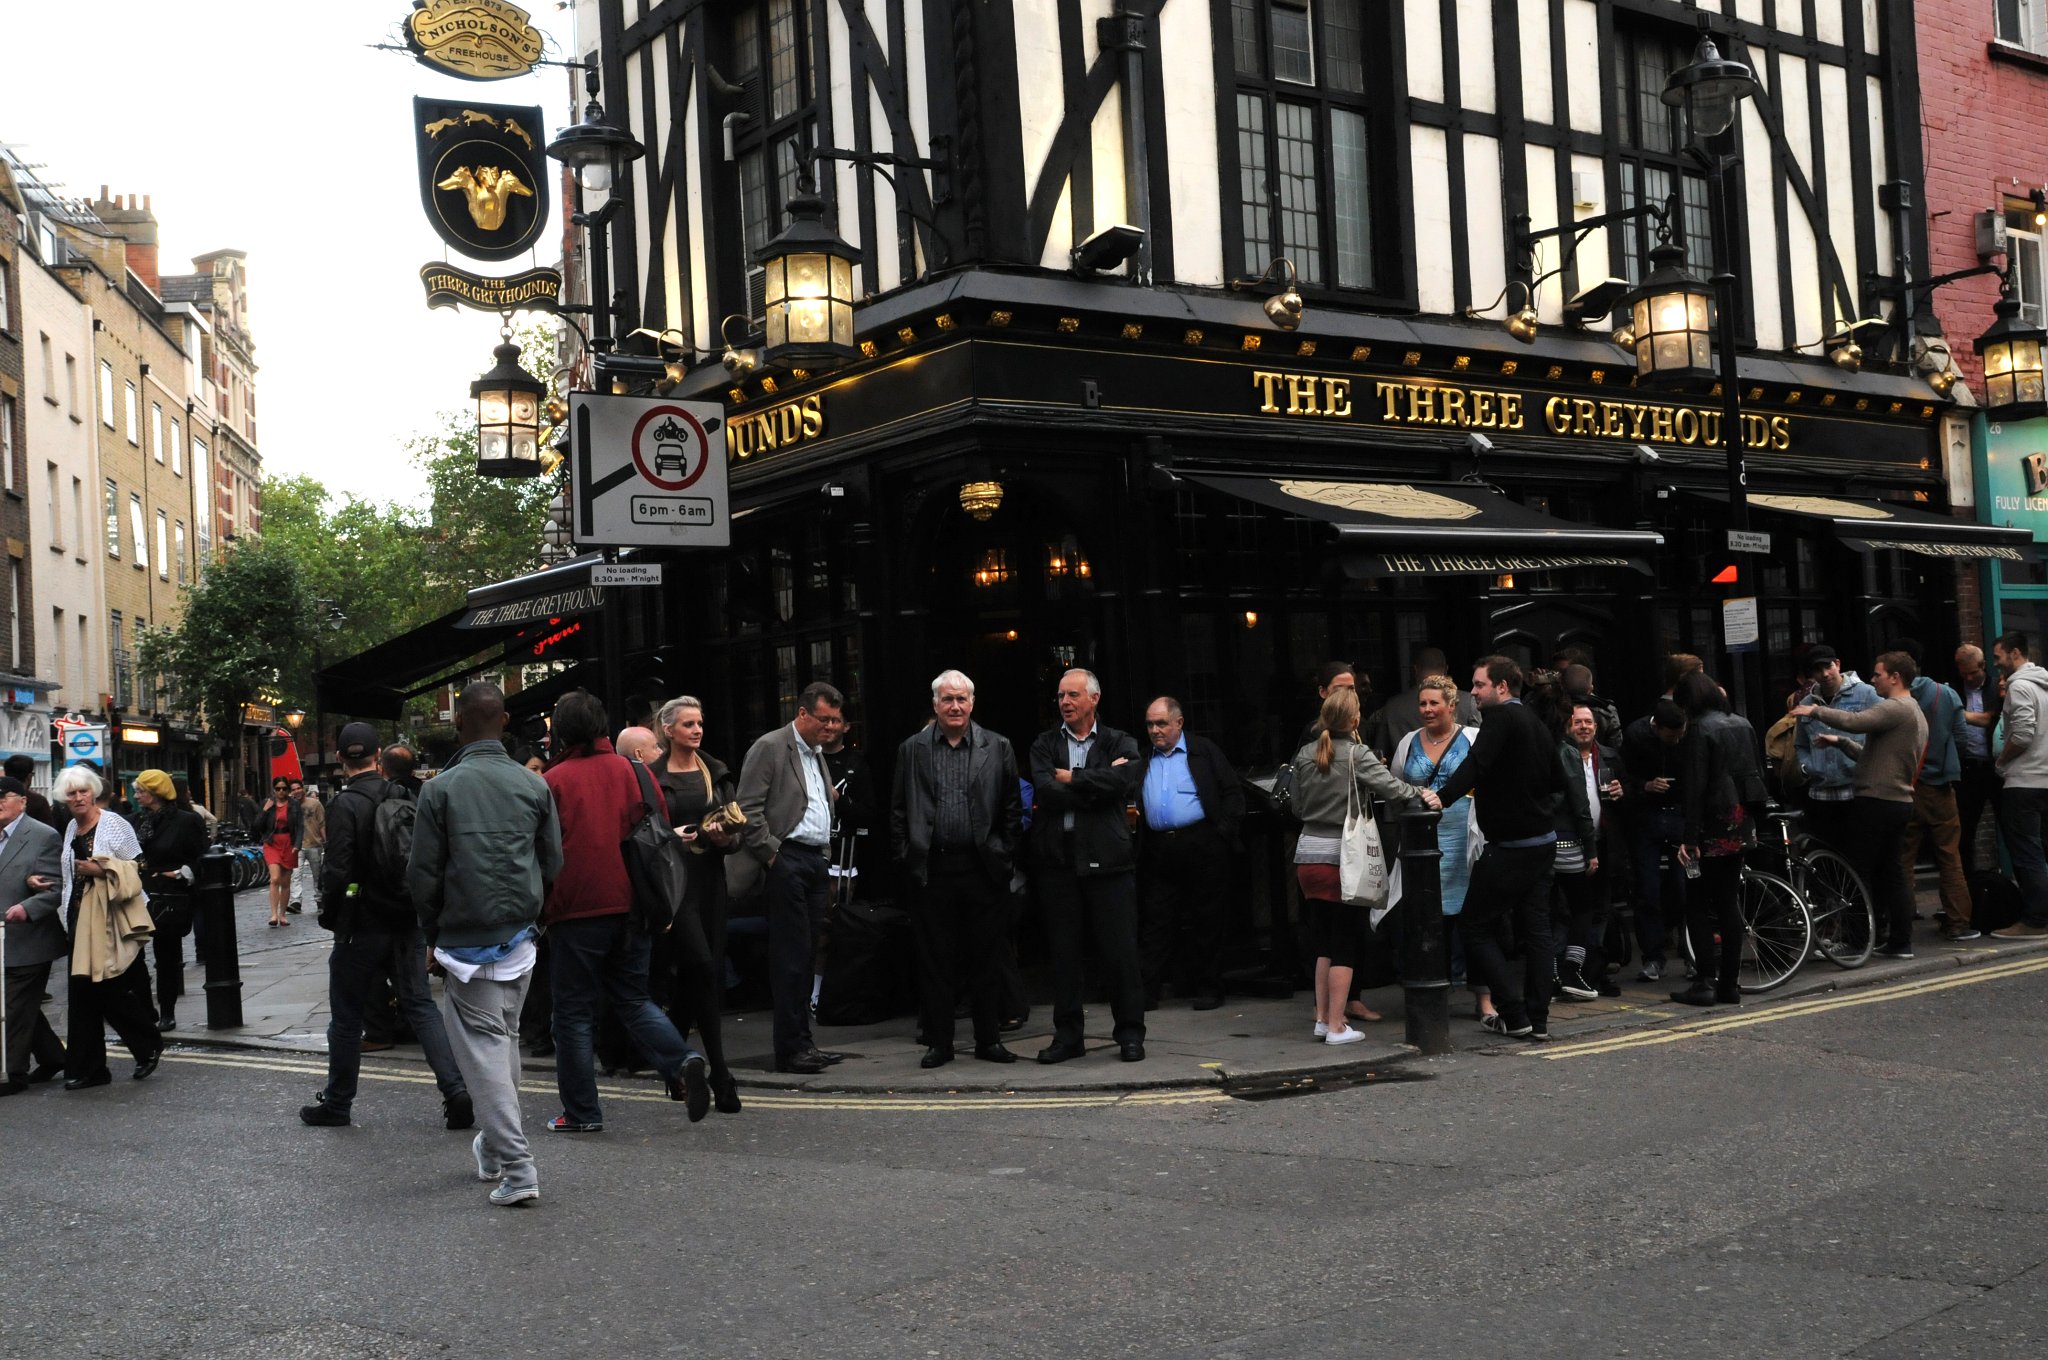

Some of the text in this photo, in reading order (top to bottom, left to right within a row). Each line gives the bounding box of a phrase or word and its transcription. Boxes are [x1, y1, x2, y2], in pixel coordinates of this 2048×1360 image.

[428, 19, 531, 54] NICHOLSON'S
[449, 47, 509, 63] FREEHOUSE
[428, 274, 557, 304] THREE GREYHOUNDS
[482, 279, 506, 289] THE
[1253, 370, 1790, 450] THE THREE GREYHOUDS
[1995, 495, 2020, 511] FULLY
[619, 566, 647, 575] loading
[1377, 554, 1629, 572] THE THREE GREYHOUNDS
[470, 609, 498, 626] THE
[494, 600, 533, 623] THREE
